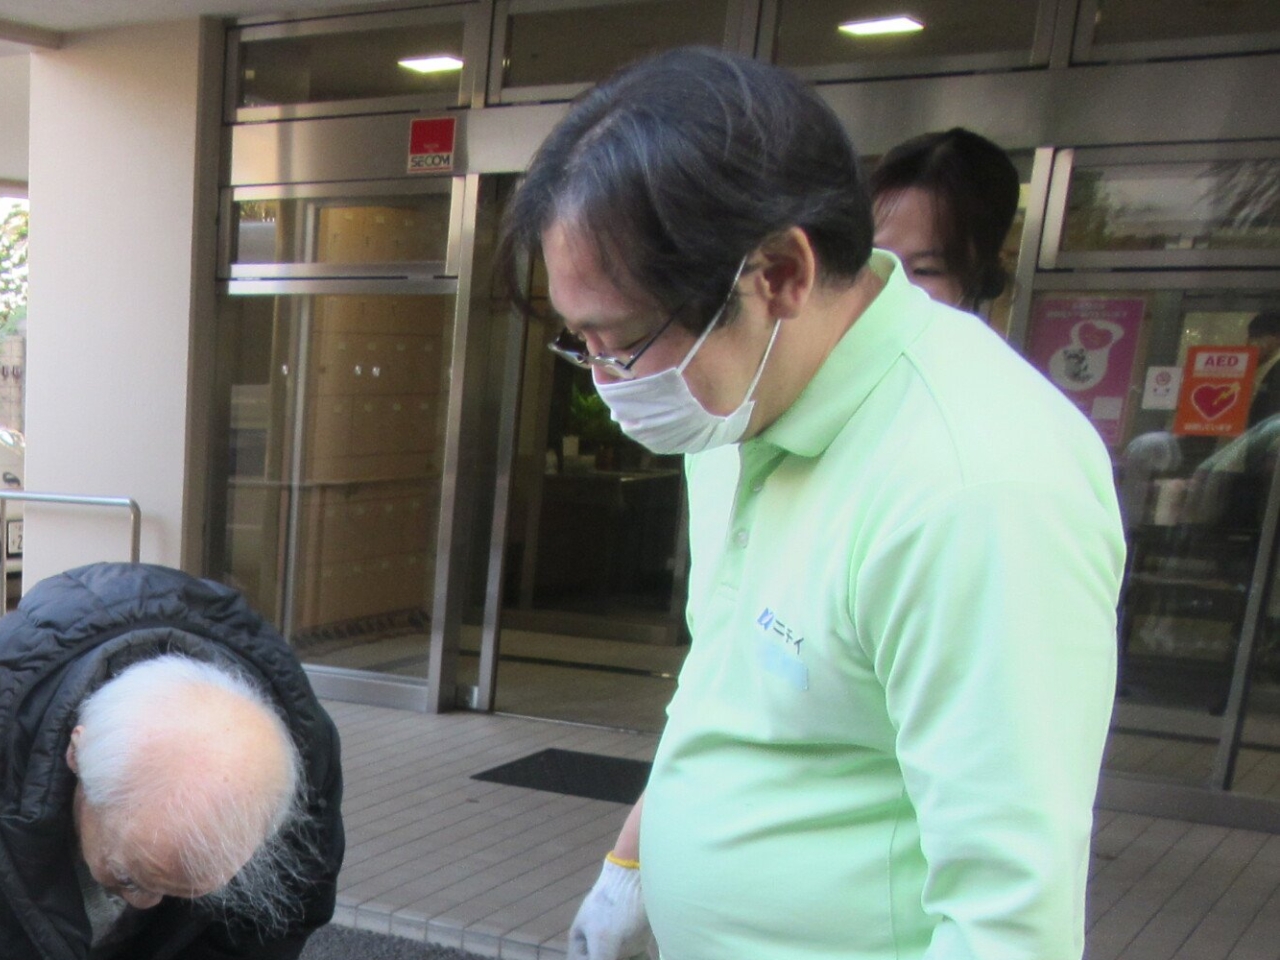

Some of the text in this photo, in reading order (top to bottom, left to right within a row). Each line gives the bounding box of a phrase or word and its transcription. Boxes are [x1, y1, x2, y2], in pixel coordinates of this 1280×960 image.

[410, 154, 451, 168] SECOM
[1204, 354, 1239, 367] AED
[773, 619, 804, 656] ニチイ
